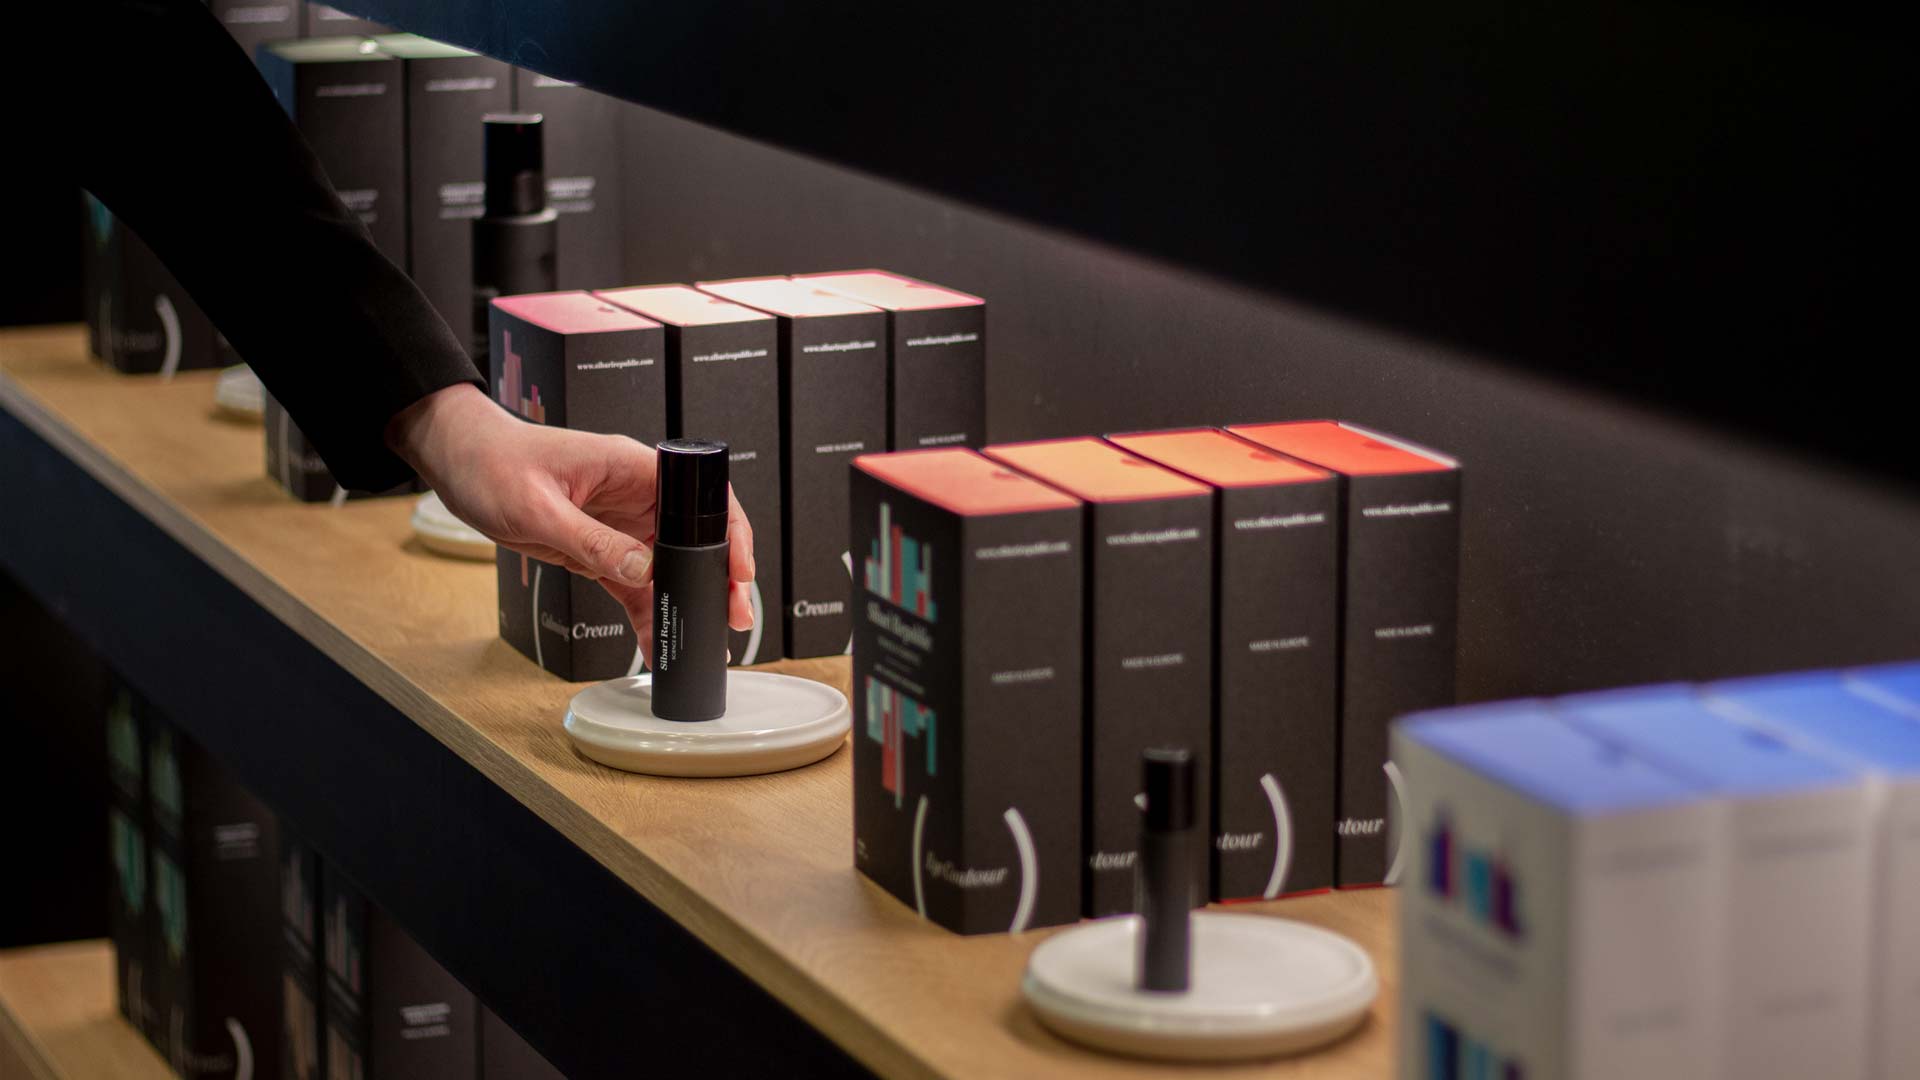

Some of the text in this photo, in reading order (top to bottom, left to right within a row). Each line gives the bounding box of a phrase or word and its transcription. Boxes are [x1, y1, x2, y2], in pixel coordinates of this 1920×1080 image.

[693, 349, 768, 362] www.sibarirepublic.com
[577, 358, 654, 371] www.sibarirepublic.com
[816, 444, 833, 454] MADE
[841, 441, 864, 452] EUROPE
[793, 600, 844, 618] Cream
[571, 621, 625, 641] Cream
[660, 592, 671, 671] Sibari Republic
